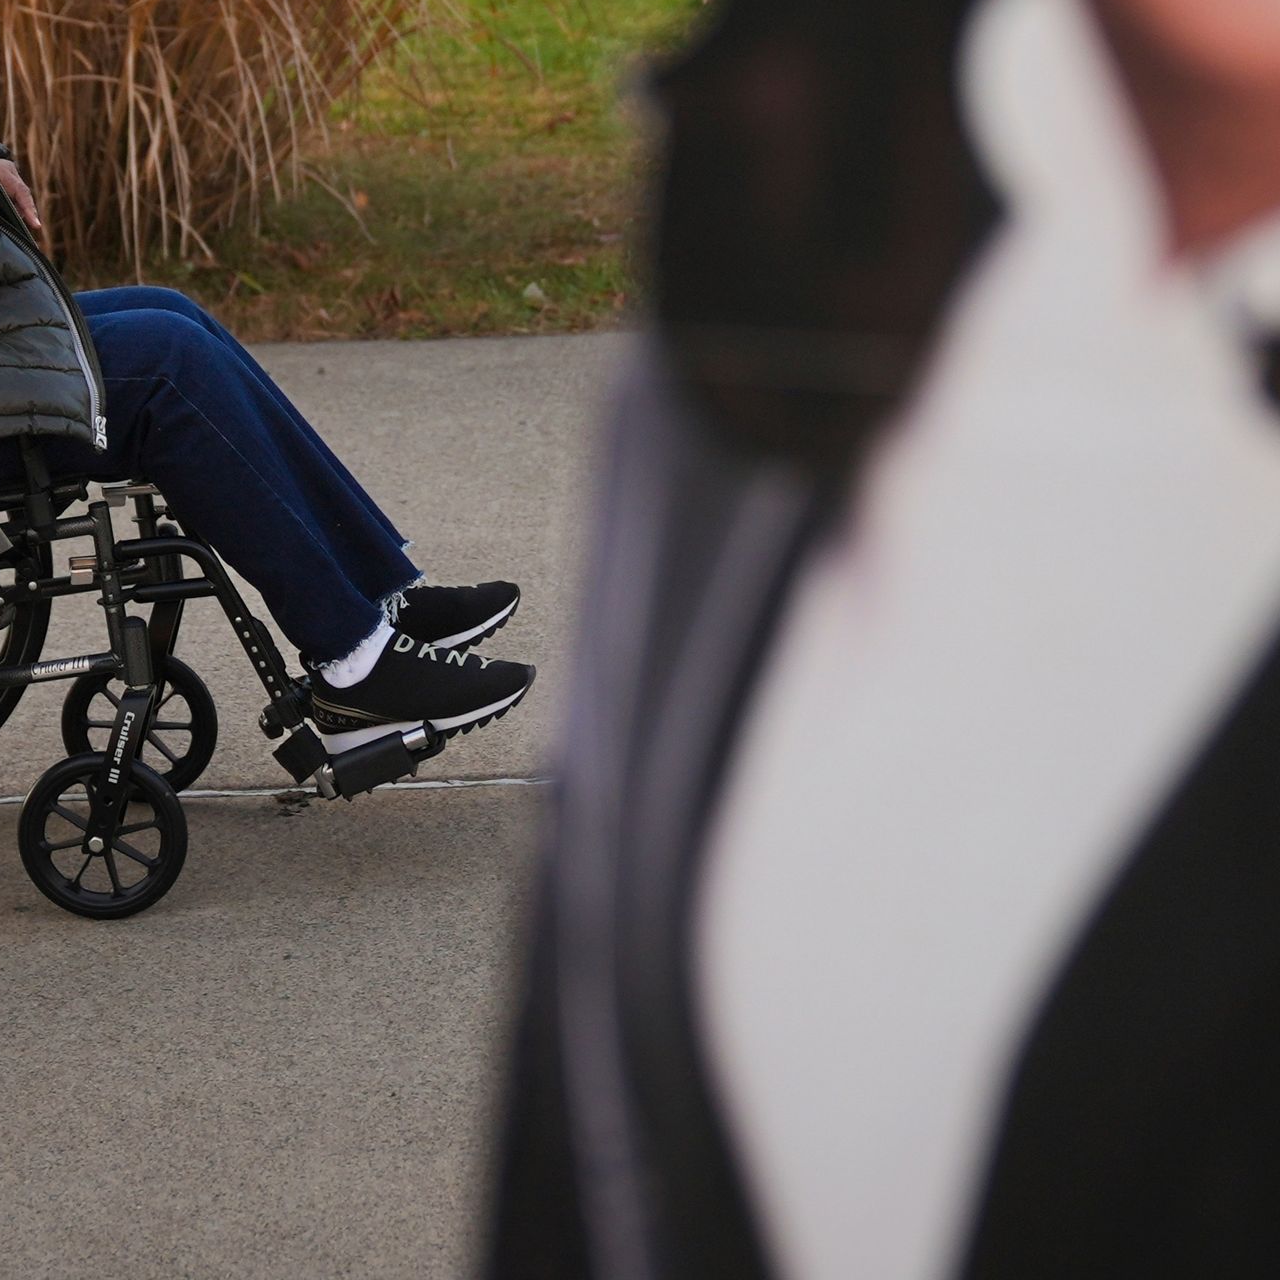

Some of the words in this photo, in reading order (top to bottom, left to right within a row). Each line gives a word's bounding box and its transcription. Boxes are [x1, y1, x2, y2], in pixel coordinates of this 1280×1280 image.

[393, 633, 496, 670] DKNY
[113, 711, 135, 765] Cruiser
[108, 767, 120, 785] III
